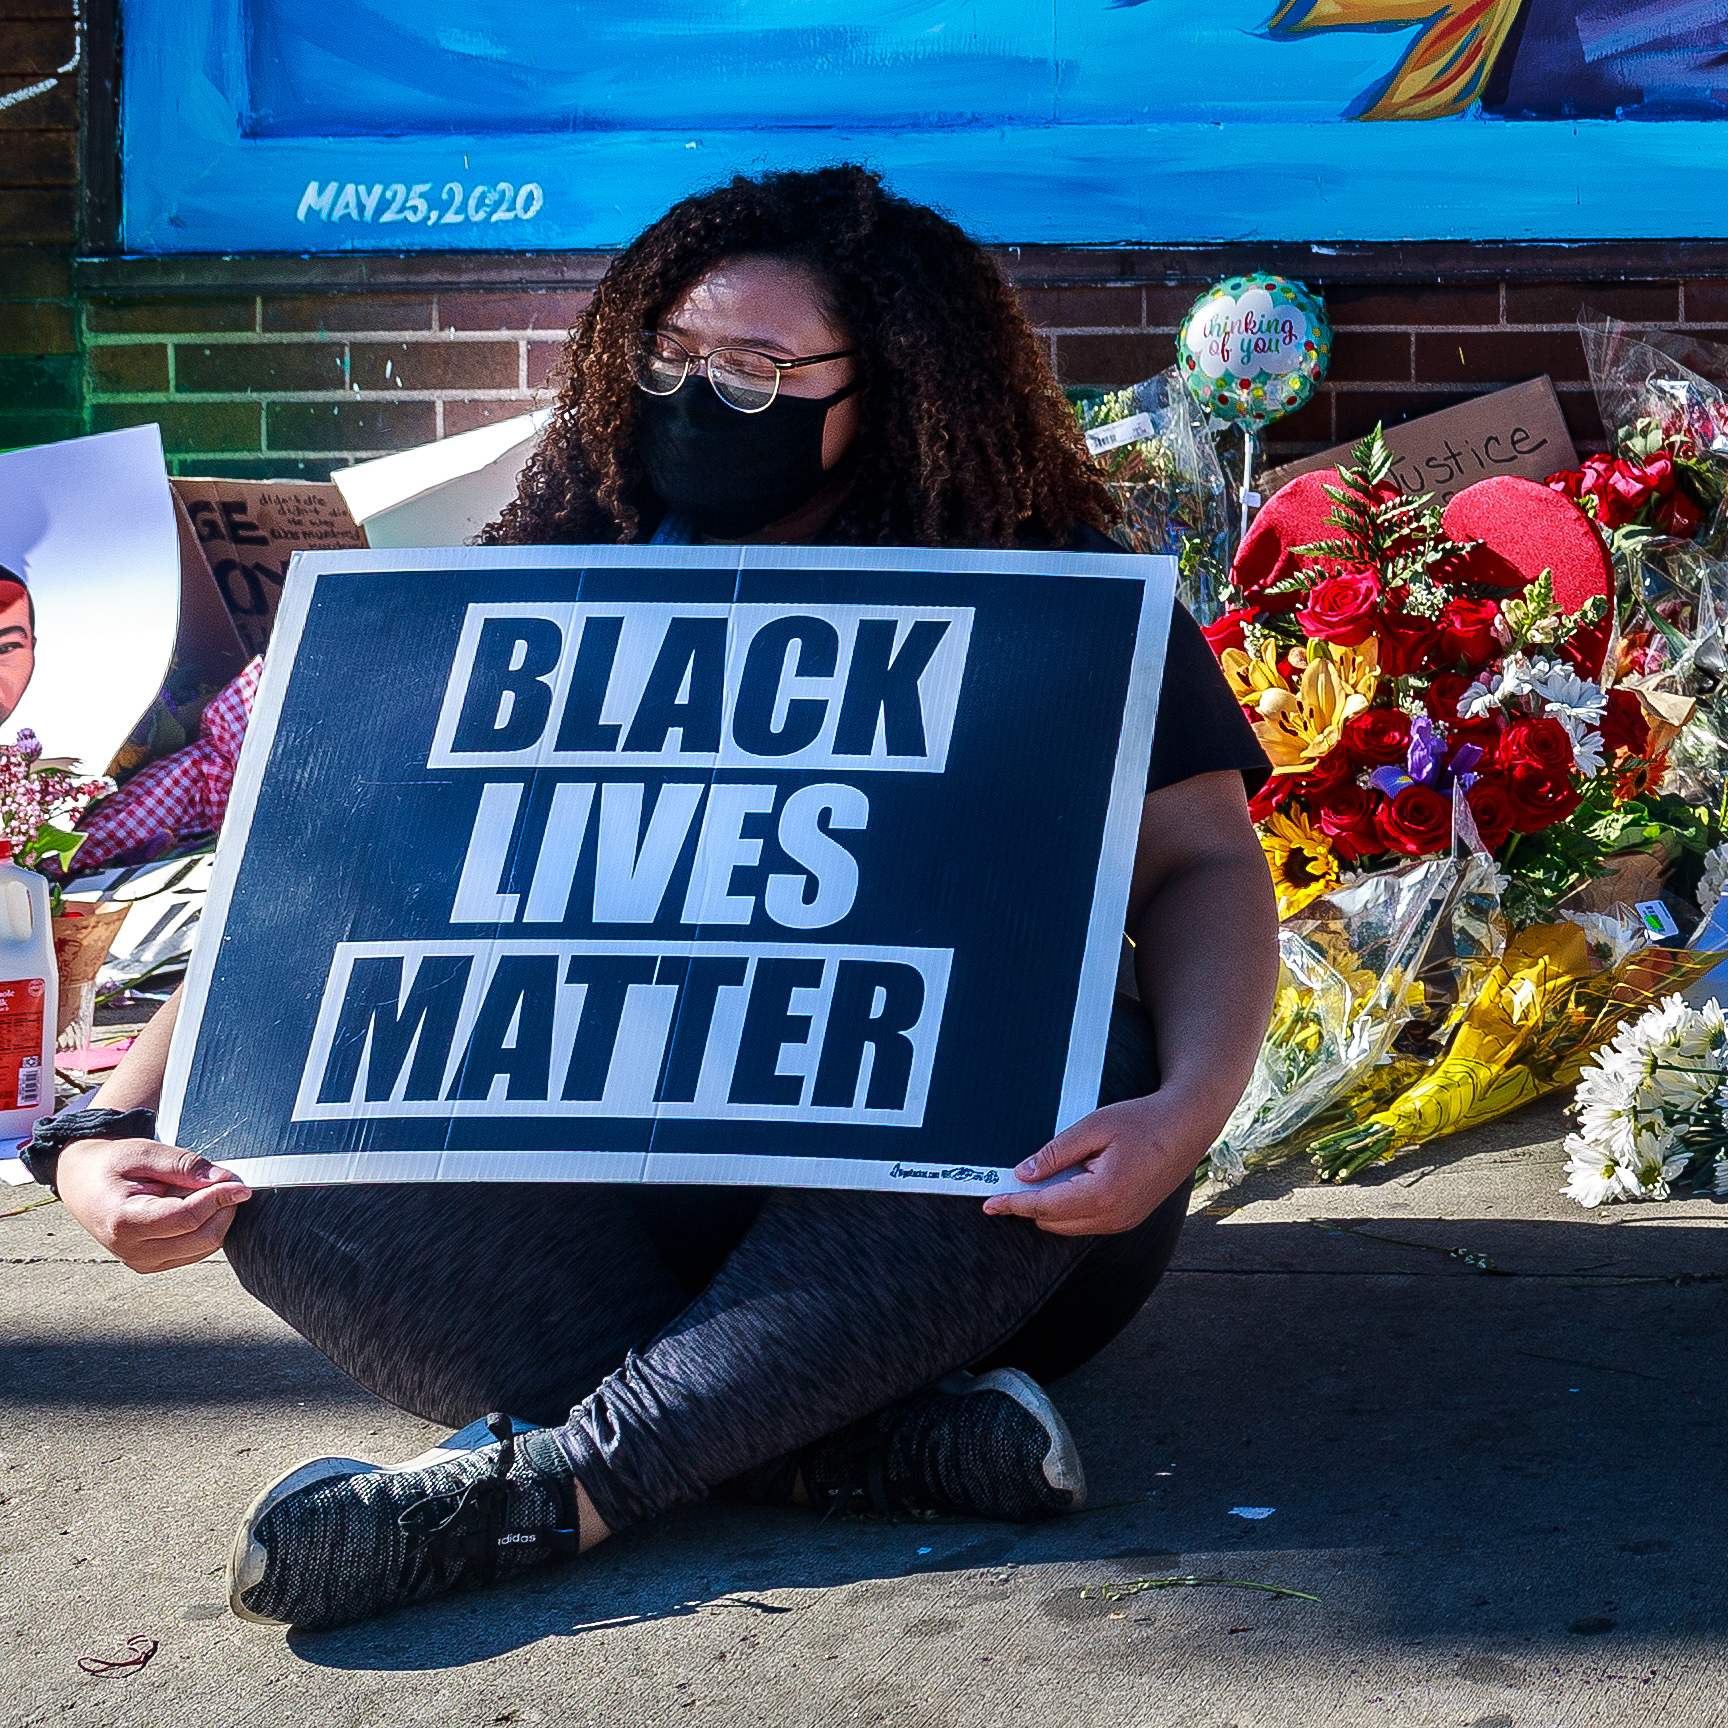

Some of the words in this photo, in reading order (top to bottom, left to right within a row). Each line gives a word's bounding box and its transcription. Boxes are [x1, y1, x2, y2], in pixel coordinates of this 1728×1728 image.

[1203, 310, 1298, 346] thinking
[1208, 331, 1233, 363] of
[1240, 337, 1280, 366] you
[449, 614, 953, 761] BLACK
[449, 780, 870, 930] LIVES
[315, 954, 926, 1113] MATTER
